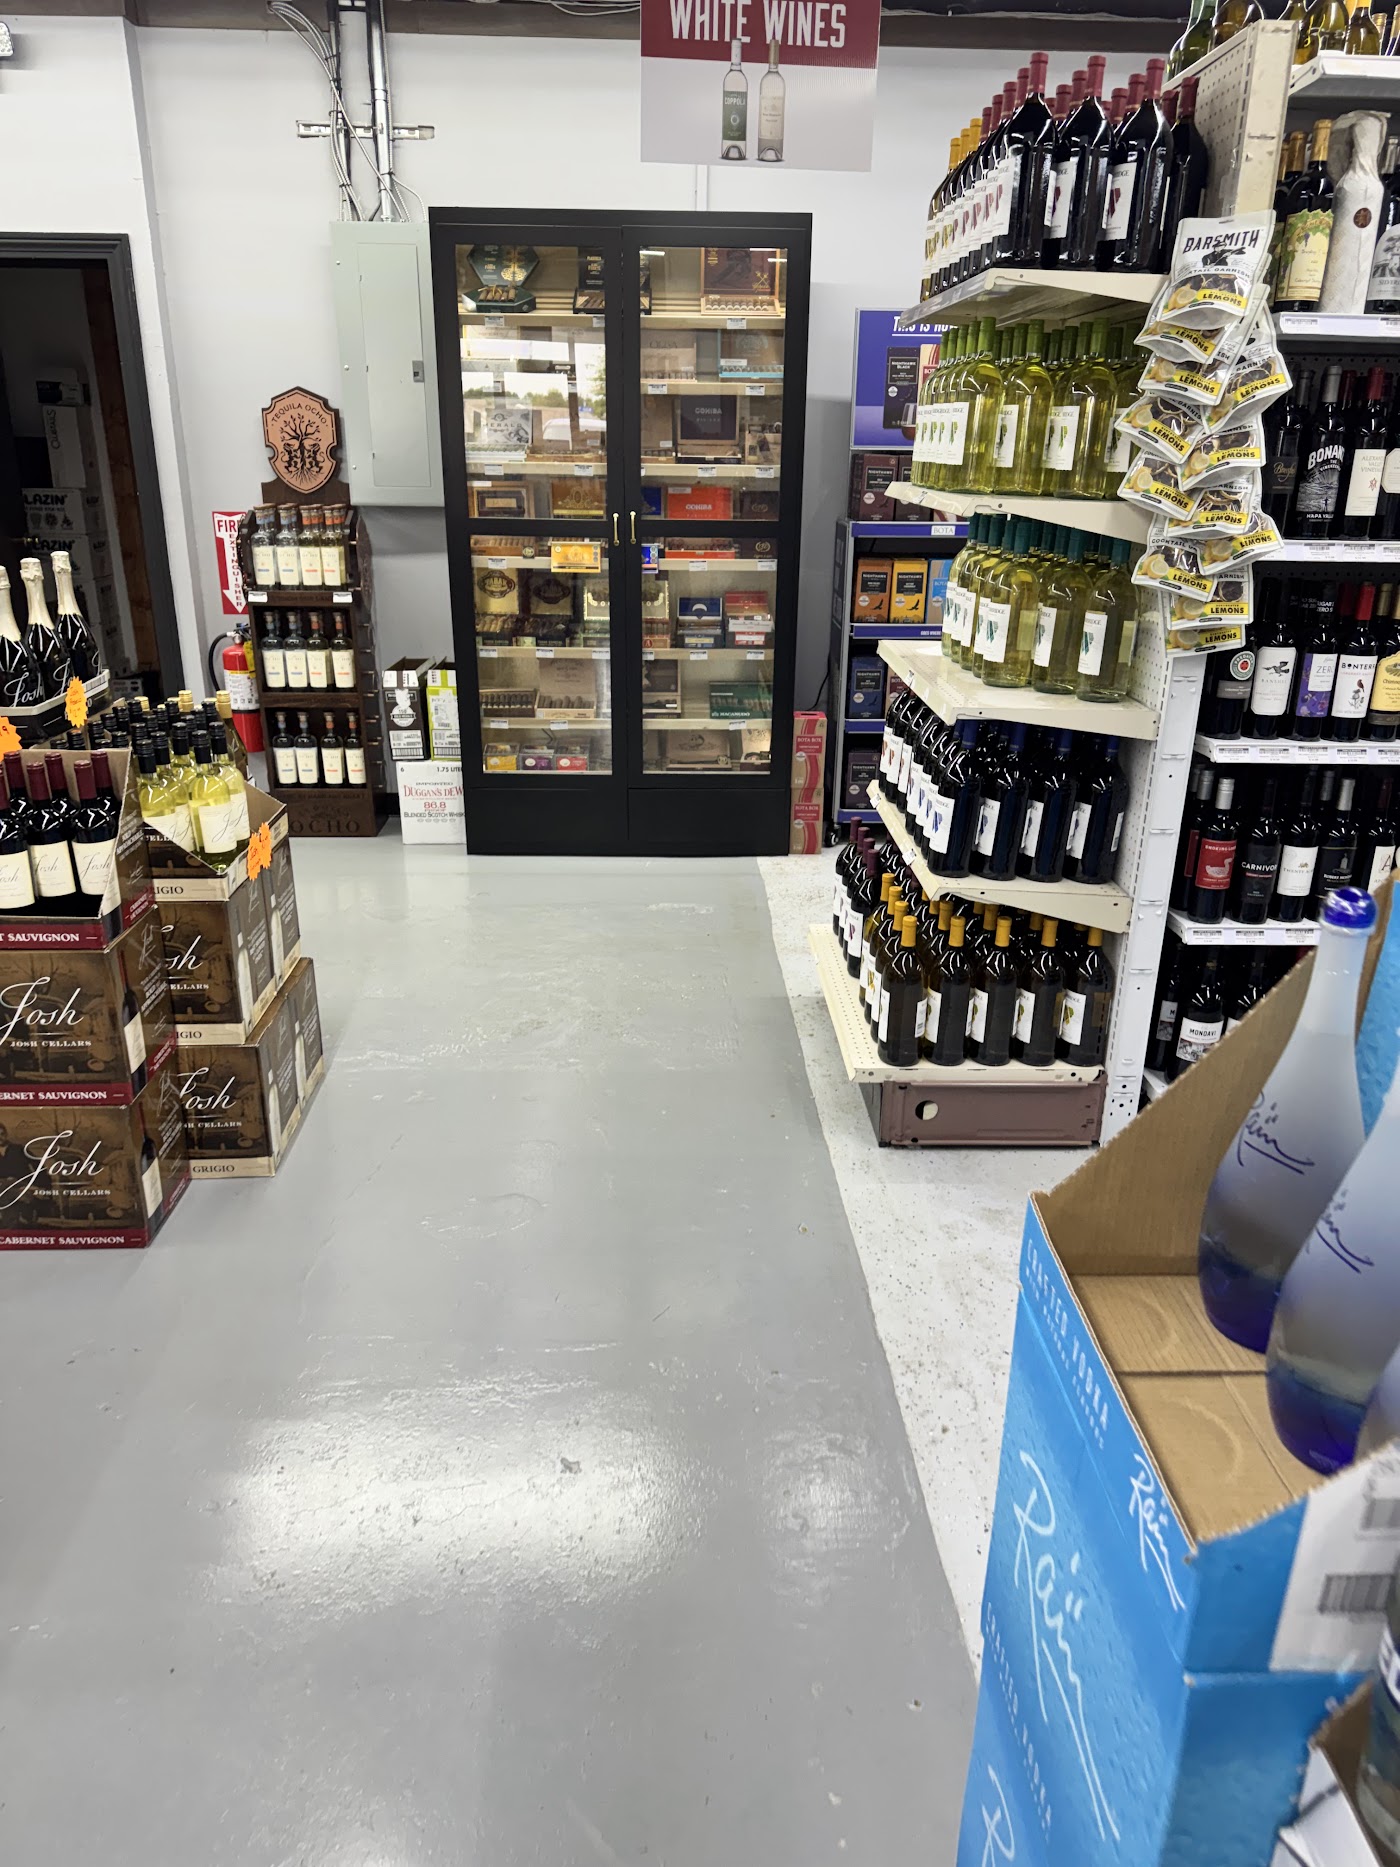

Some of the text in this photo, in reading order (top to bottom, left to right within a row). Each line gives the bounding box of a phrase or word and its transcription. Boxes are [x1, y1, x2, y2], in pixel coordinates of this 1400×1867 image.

[670, 0, 848, 48] WHITE WINES
[1183, 229, 1260, 255] BARSMITH
[1202, 293, 1242, 307] LEMONS
[1176, 330, 1209, 352] LEMONS
[1180, 375, 1215, 393] LEMONS
[1240, 379, 1281, 398] LEMONS
[271, 402, 329, 425] TEQUILA OCHO
[1153, 427, 1185, 451] LEMONS
[1217, 452, 1255, 462] LEMONS
[1155, 488, 1189, 508] LEMONS
[1205, 515, 1242, 524] LEMONS
[1240, 535, 1272, 548] LEMONS
[1173, 574, 1208, 590] LEMONS
[1205, 632, 1237, 643] LEMONS
[8, 932, 80, 942] SAUVIGNON
[0, 976, 84, 1046] Josh
[9, 1039, 92, 1047] JOSH CELLARS
[38, 1090, 107, 1100] SAUVIGNON
[0, 1130, 104, 1210] Josh
[193, 1165, 235, 1173] GRIGIO
[59, 1188, 111, 1196] CELLARS
[59, 1235, 125, 1244] SAUVIGNON
